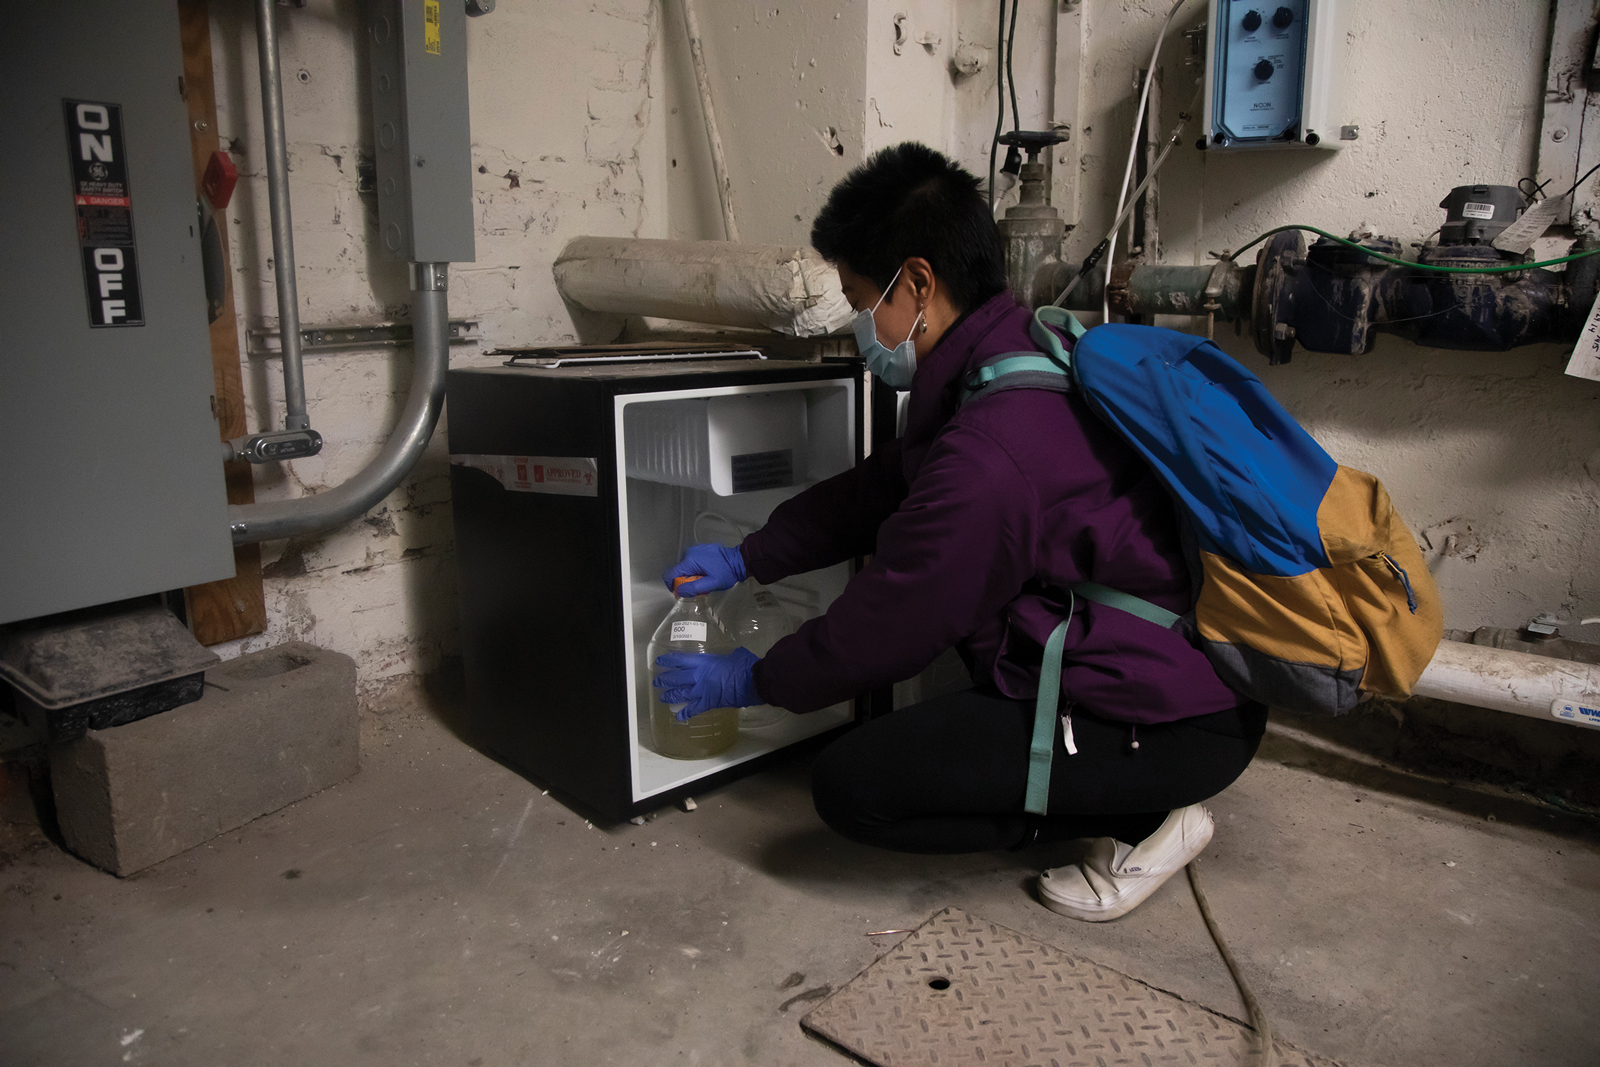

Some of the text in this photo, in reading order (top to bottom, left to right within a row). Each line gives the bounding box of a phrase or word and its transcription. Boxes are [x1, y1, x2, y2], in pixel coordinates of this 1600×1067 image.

[76, 103, 113, 162] ON
[90, 197, 124, 205] DANGER
[94, 247, 126, 324] OFF
[546, 468, 581, 478] APPROVED
